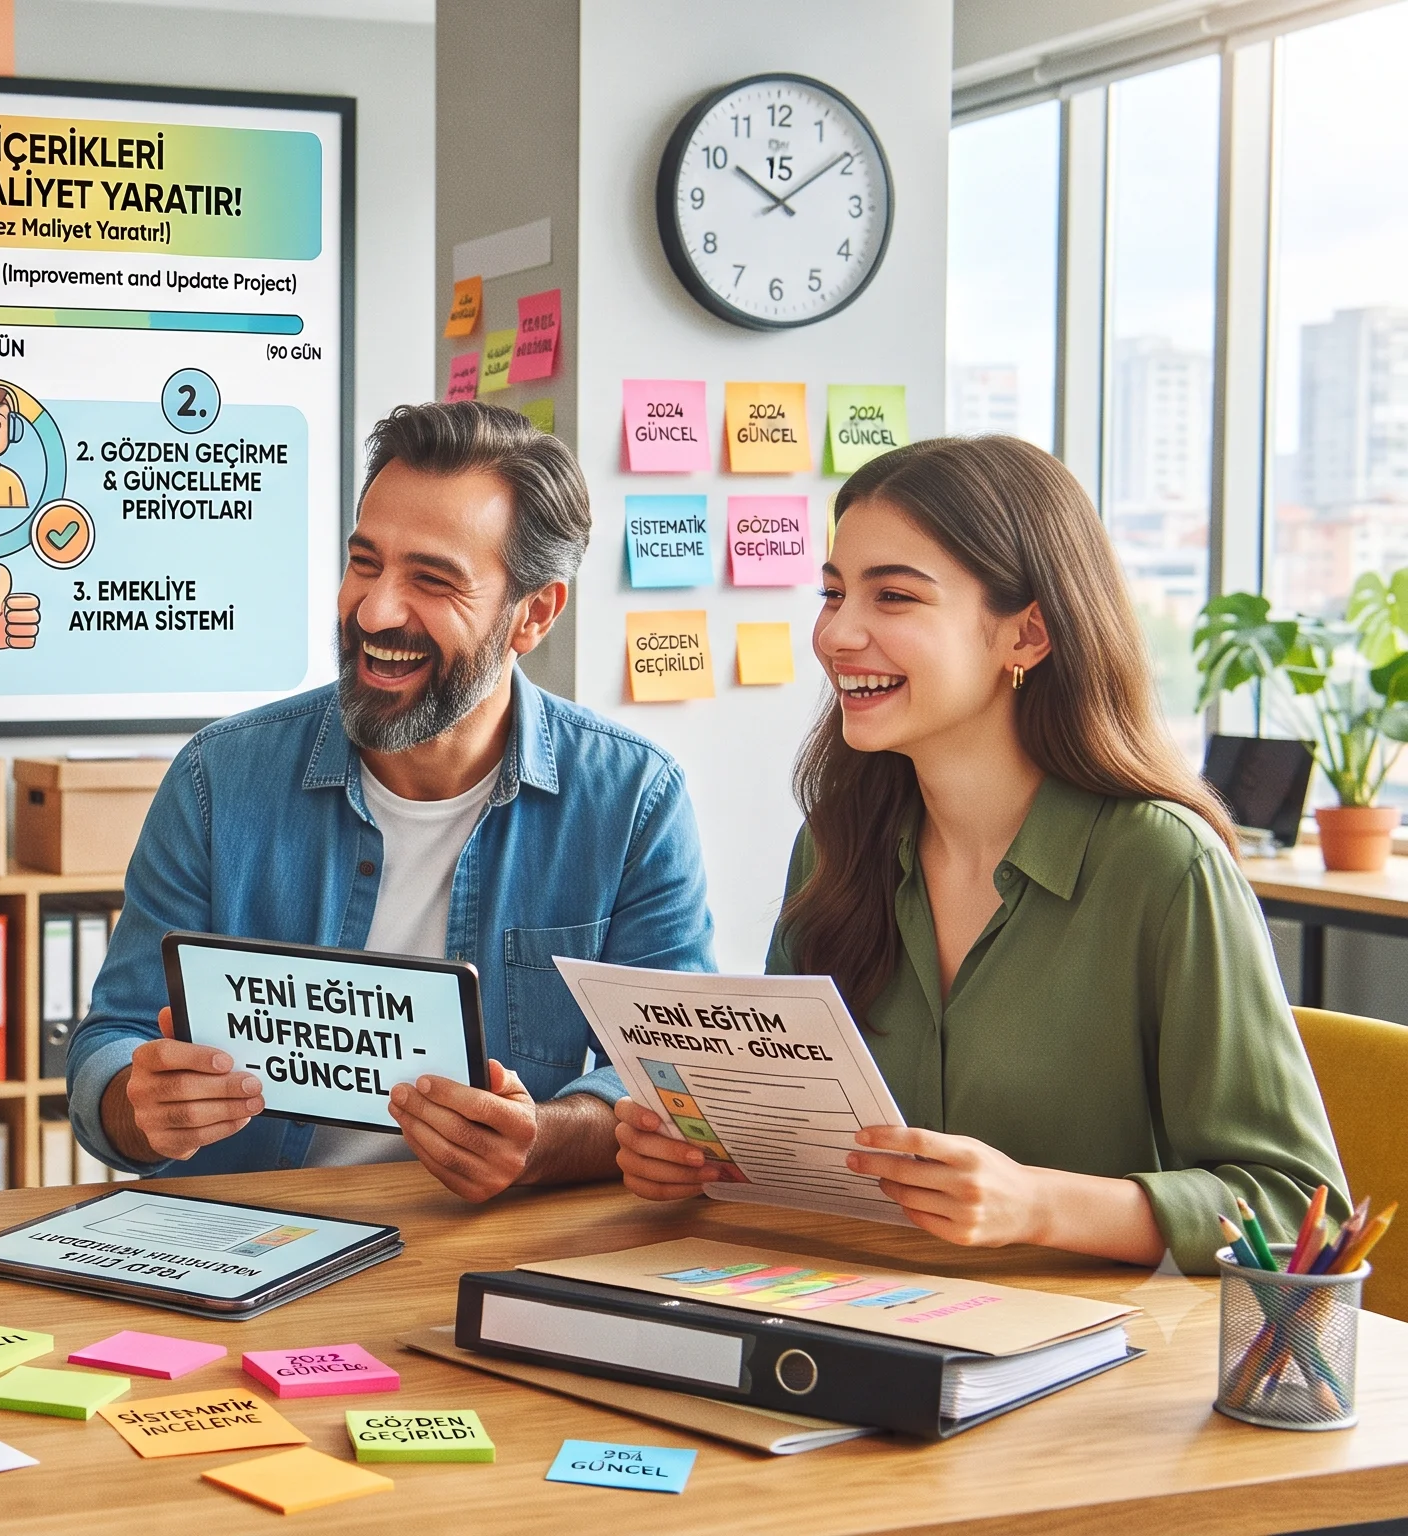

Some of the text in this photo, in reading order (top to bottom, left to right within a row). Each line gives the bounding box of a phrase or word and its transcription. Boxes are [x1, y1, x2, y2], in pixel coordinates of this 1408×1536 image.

[730, 114, 751, 138] 11
[767, 104, 793, 128] 12
[814, 120, 824, 143] 1
[702, 145, 728, 169] 10
[766, 156, 793, 181] 15
[840, 152, 854, 175] 2
[100, 181, 243, 217] YARATIR!
[690, 187, 705, 210] 9
[848, 195, 863, 219] 3
[22, 217, 91, 243] Maliyet
[96, 220, 171, 245] Yaratır!)
[703, 232, 718, 254] 8
[837, 238, 853, 262] 4
[2, 263, 123, 288] (Improvement
[128, 271, 161, 288] and
[166, 270, 229, 293] Update
[234, 273, 297, 296] Project)
[732, 264, 746, 288] 7
[808, 269, 822, 293] 5
[769, 278, 784, 302] 6
[266, 342, 322, 361] (90 GÜN
[177, 384, 207, 418] 2.
[647, 403, 684, 418] 2024
[749, 404, 785, 419] 2024
[849, 405, 884, 422] 2024
[635, 421, 698, 443] GÜNCEL
[737, 422, 798, 443] GÜNCEL
[839, 422, 898, 447] GÜNCEL
[76, 437, 288, 469] 2. GÖZDEN GEÇİRME
[103, 466, 262, 492] & GÜNCELLEME
[122, 493, 252, 520] PERİYOTLARI
[631, 514, 707, 535] SİSTEMATİK
[636, 538, 704, 558] İNCELEME
[73, 575, 196, 602] 3. EMEKLİYE
[69, 604, 234, 631] AYIRMA SİSTEMİ
[636, 632, 699, 651] GÖZDEN
[634, 652, 704, 677] GEÇİRİLDİ
[225, 974, 414, 1023] YENİ EĞİTİM
[633, 1003, 786, 1034] YENİ EĞİTİM
[227, 1009, 402, 1061] MÜFREDATI
[619, 1024, 734, 1056] MÜFREDATI
[748, 1036, 834, 1062] GÜNCEL
[118, 1399, 258, 1424] SİSTEMATİK
[139, 1414, 262, 1436] İNCELEME
